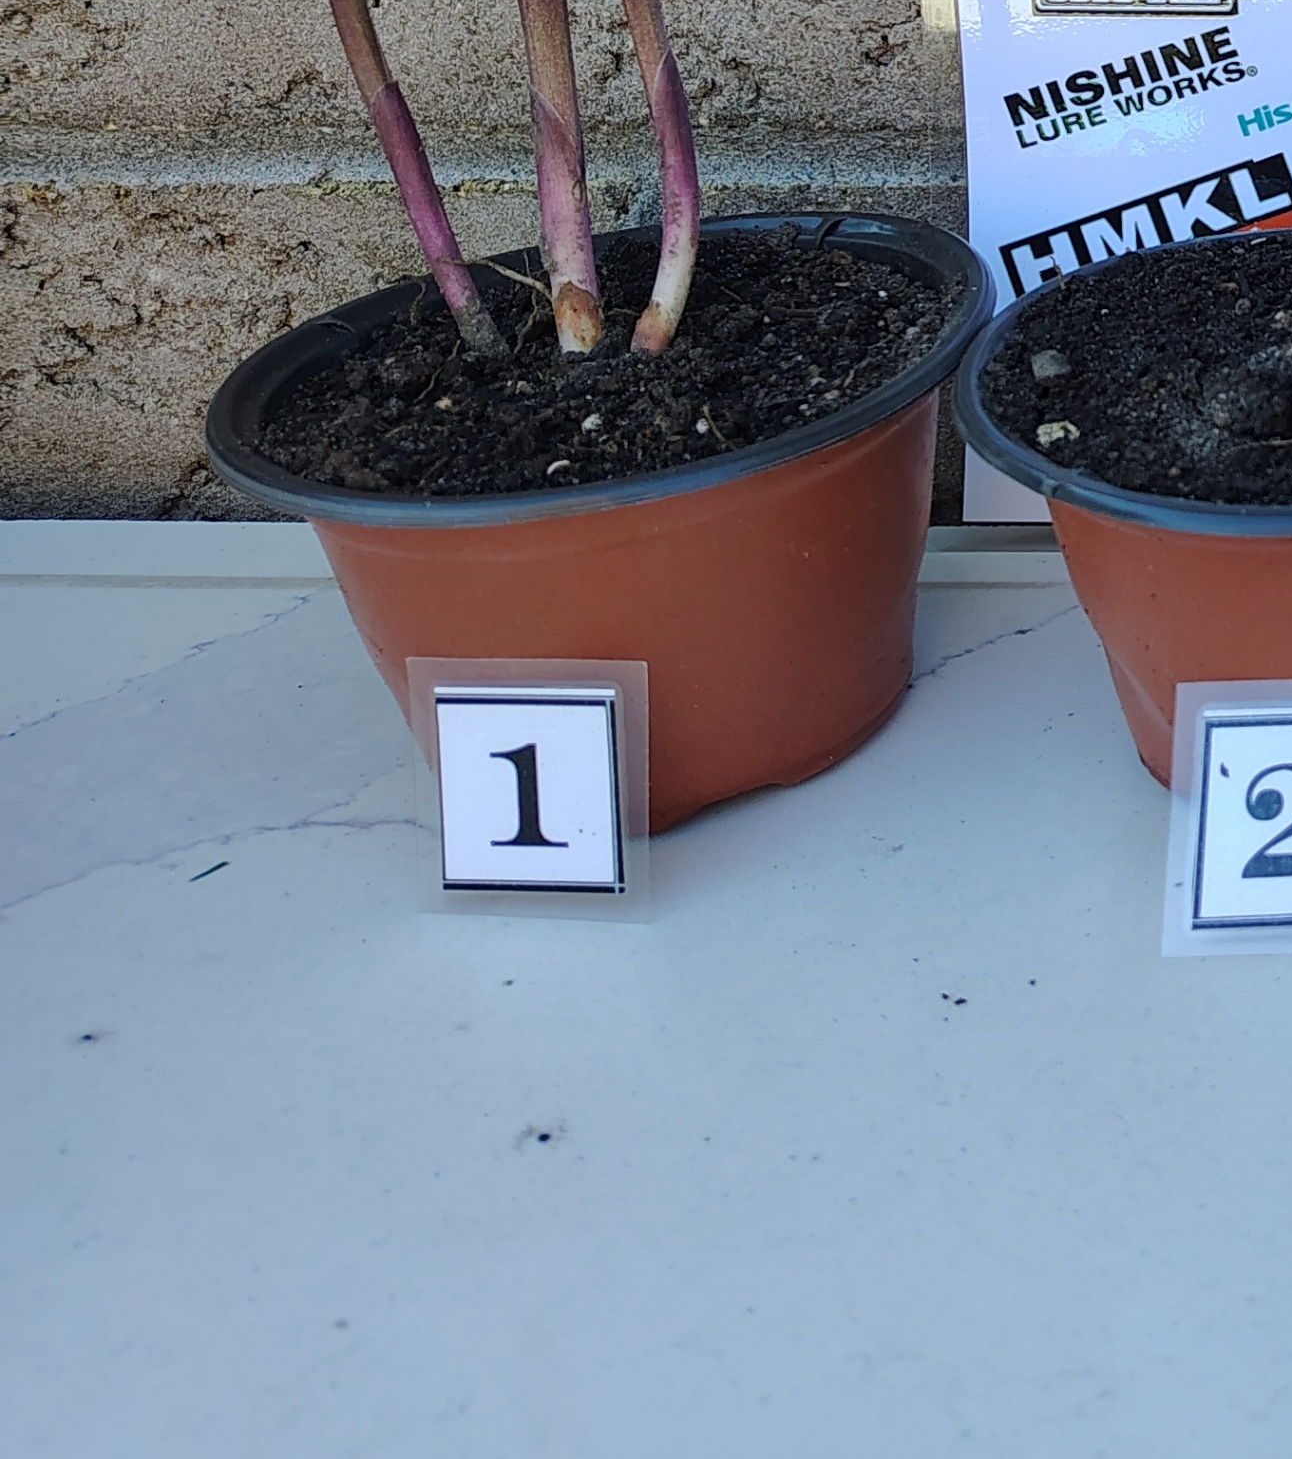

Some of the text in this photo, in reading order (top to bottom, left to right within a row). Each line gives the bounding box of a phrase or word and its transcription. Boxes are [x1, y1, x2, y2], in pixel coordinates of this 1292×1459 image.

[1004, 26, 1238, 127] NISHINE
[1016, 61, 1246, 149] LURE WORKS
[1010, 167, 1292, 294] HMKL
[490, 745, 568, 848] 1
